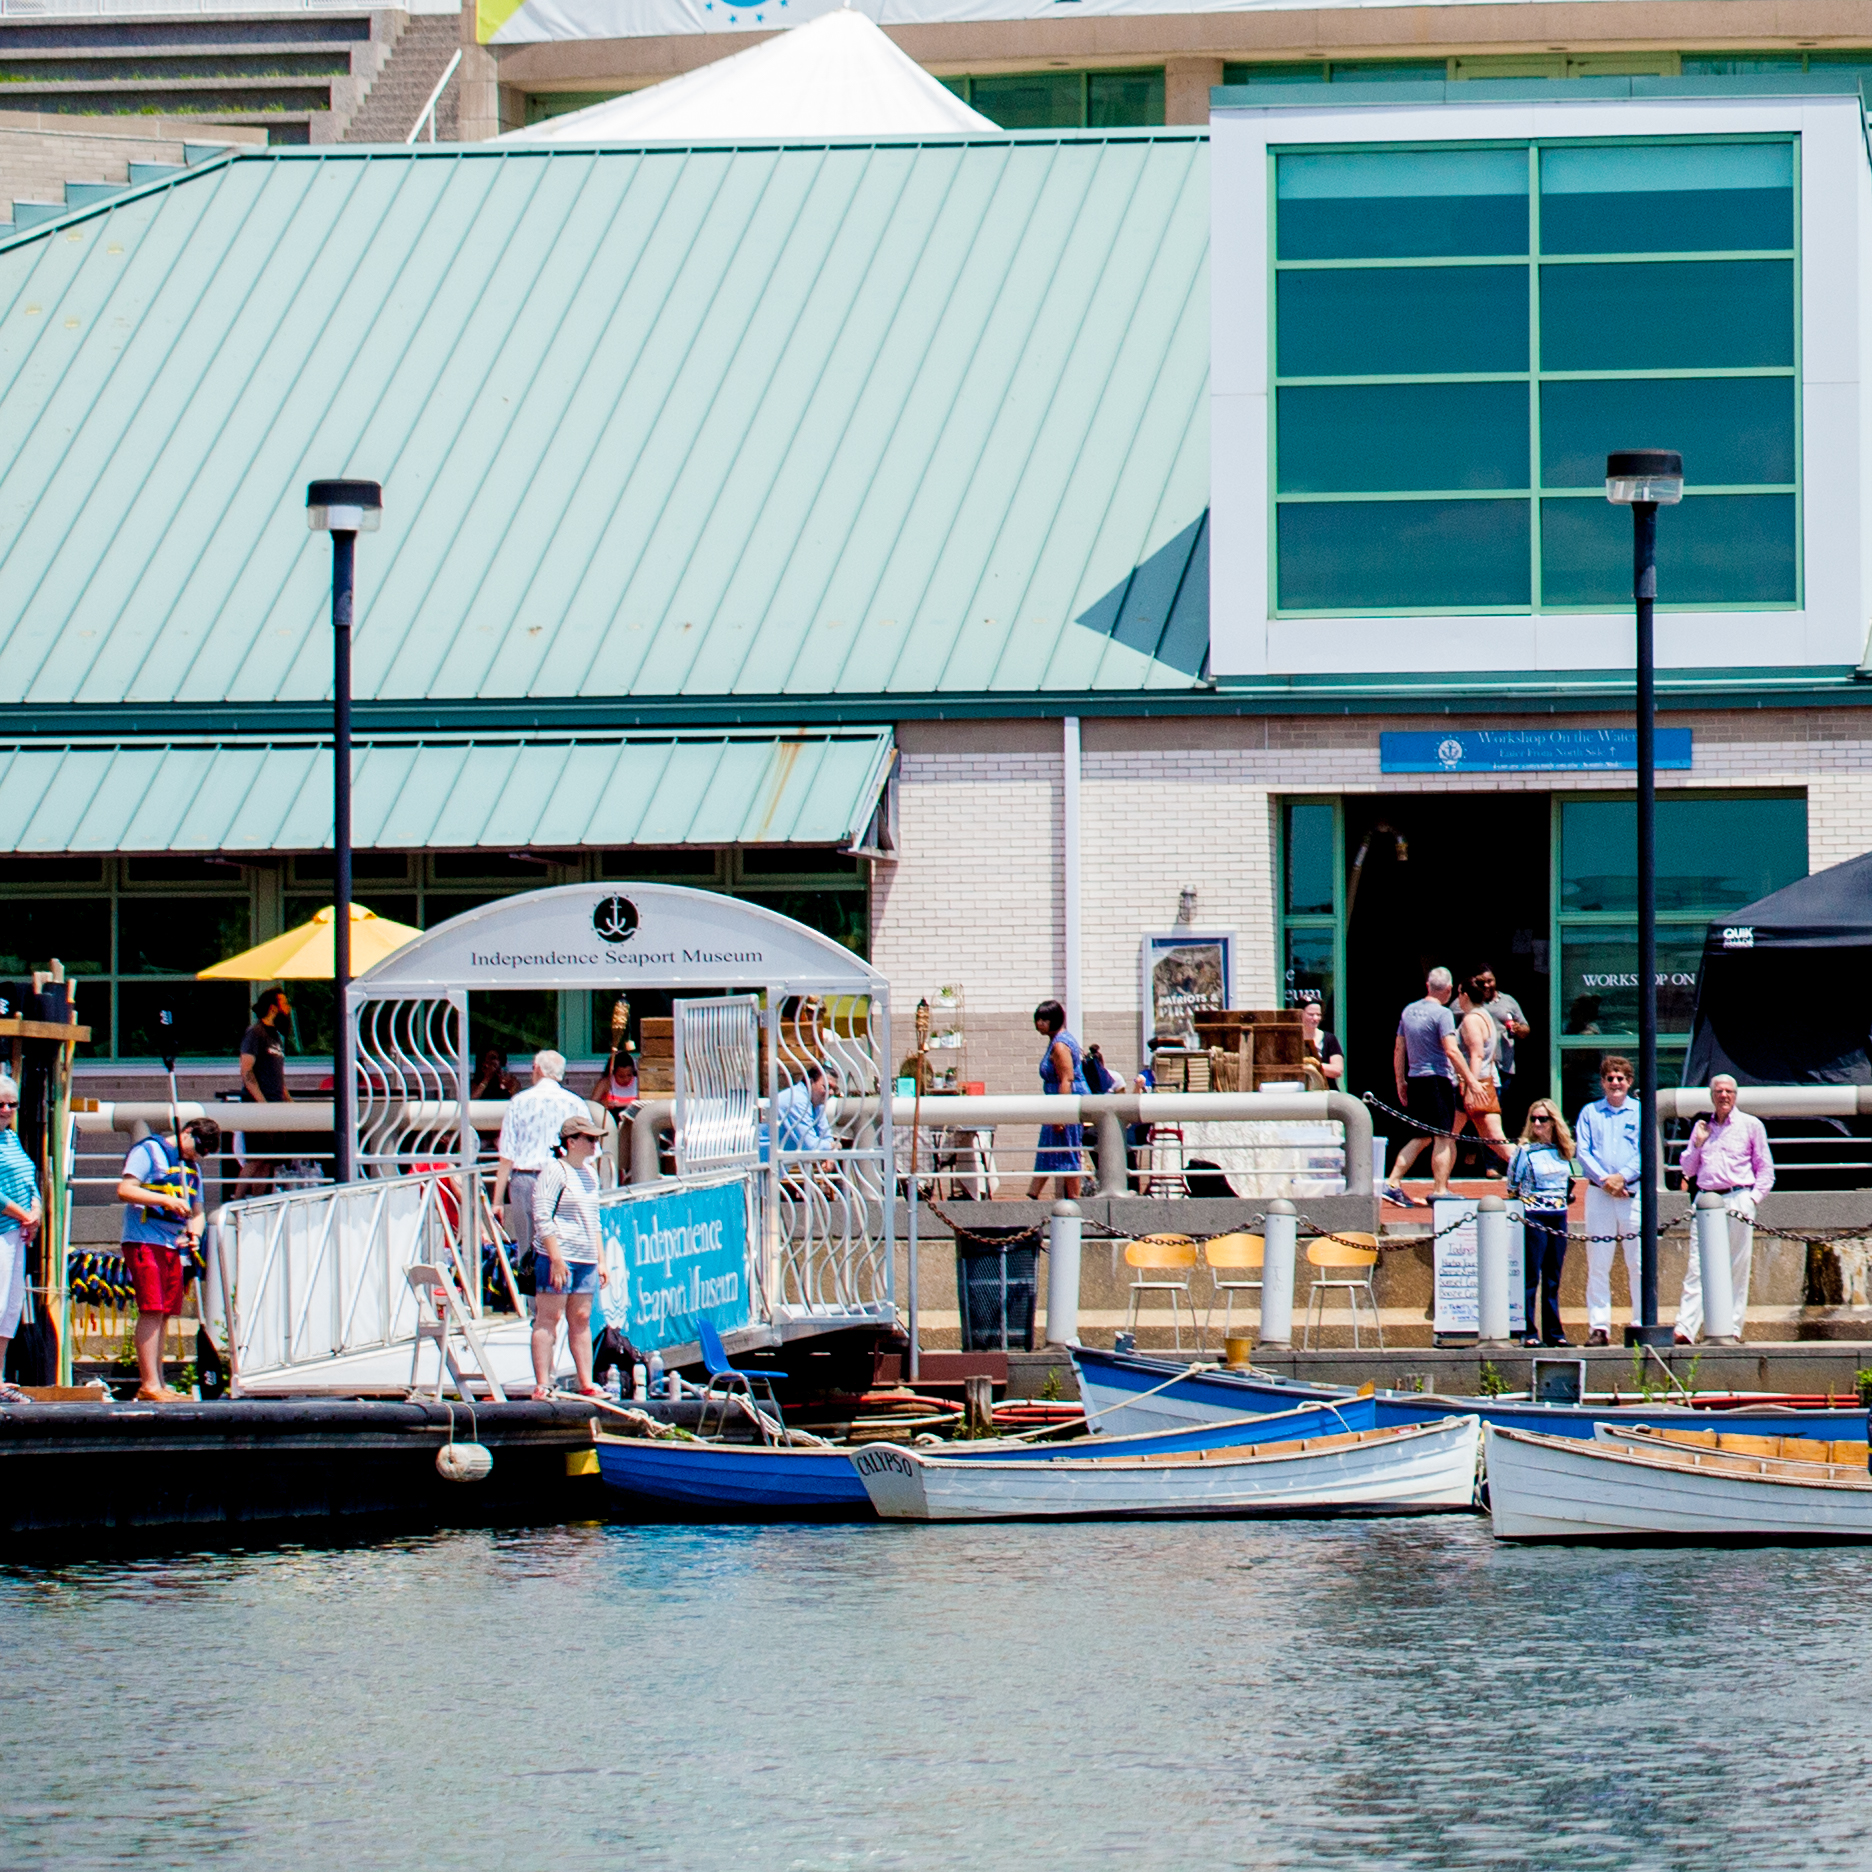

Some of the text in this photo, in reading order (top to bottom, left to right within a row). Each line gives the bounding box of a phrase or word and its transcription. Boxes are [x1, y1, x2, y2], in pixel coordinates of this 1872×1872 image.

[1477, 730, 1638, 747] Workshop On the Water
[471, 948, 763, 969] Independence Seaport Museum
[1671, 972, 1696, 986] ON
[856, 1451, 913, 1478] CALYPSO
